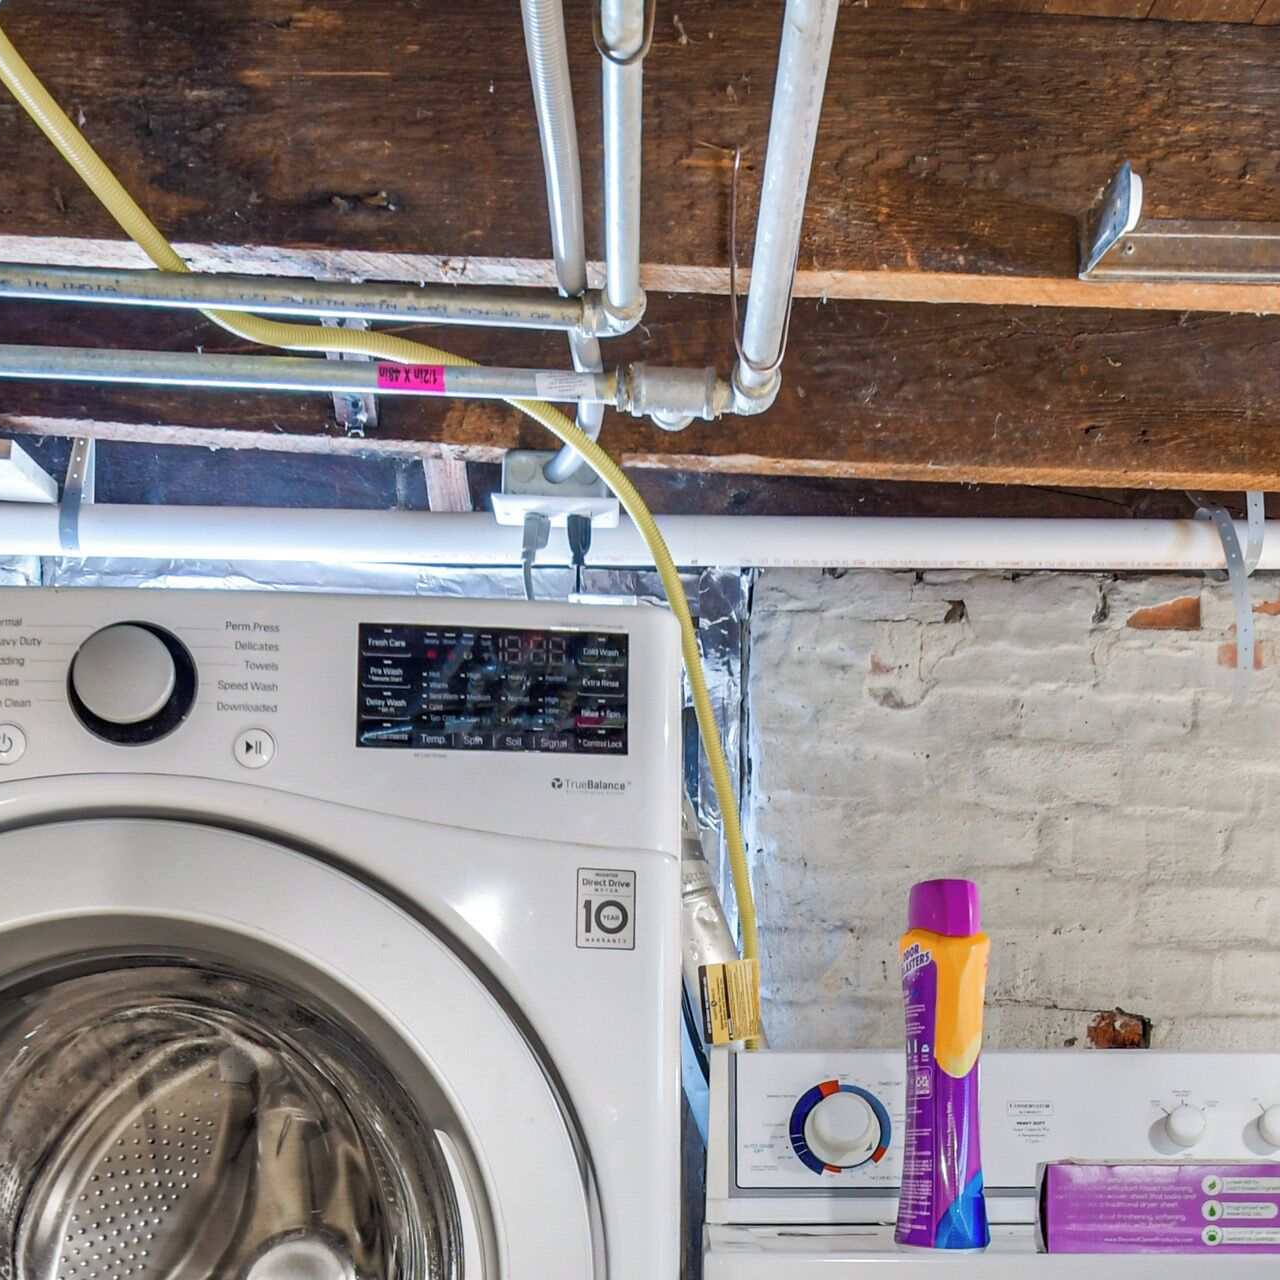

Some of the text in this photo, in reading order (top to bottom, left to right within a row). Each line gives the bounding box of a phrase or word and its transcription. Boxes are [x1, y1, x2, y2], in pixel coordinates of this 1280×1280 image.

[404, 367, 411, 383] X
[19, 637, 42, 647] Duty
[234, 640, 280, 652] Delicates
[368, 637, 406, 648] Fresh Care
[583, 648, 620, 657] Cold Wash
[244, 660, 279, 671] Towels
[383, 667, 403, 676] Wash
[217, 680, 279, 692] Speed Wash
[582, 679, 620, 688] Extra Rinse
[4, 698, 32, 708] Clean
[216, 701, 278, 713] Downloaded
[365, 697, 407, 708] Delay Wash
[420, 733, 448, 746] Temp.
[463, 735, 484, 746] Spin
[506, 736, 522, 747] Soil
[540, 738, 568, 749] Signal
[607, 739, 623, 748] Lock
[564, 779, 626, 791] TrueBalance
[582, 878, 631, 889] Direct Drive
[583, 899, 629, 935] 10
